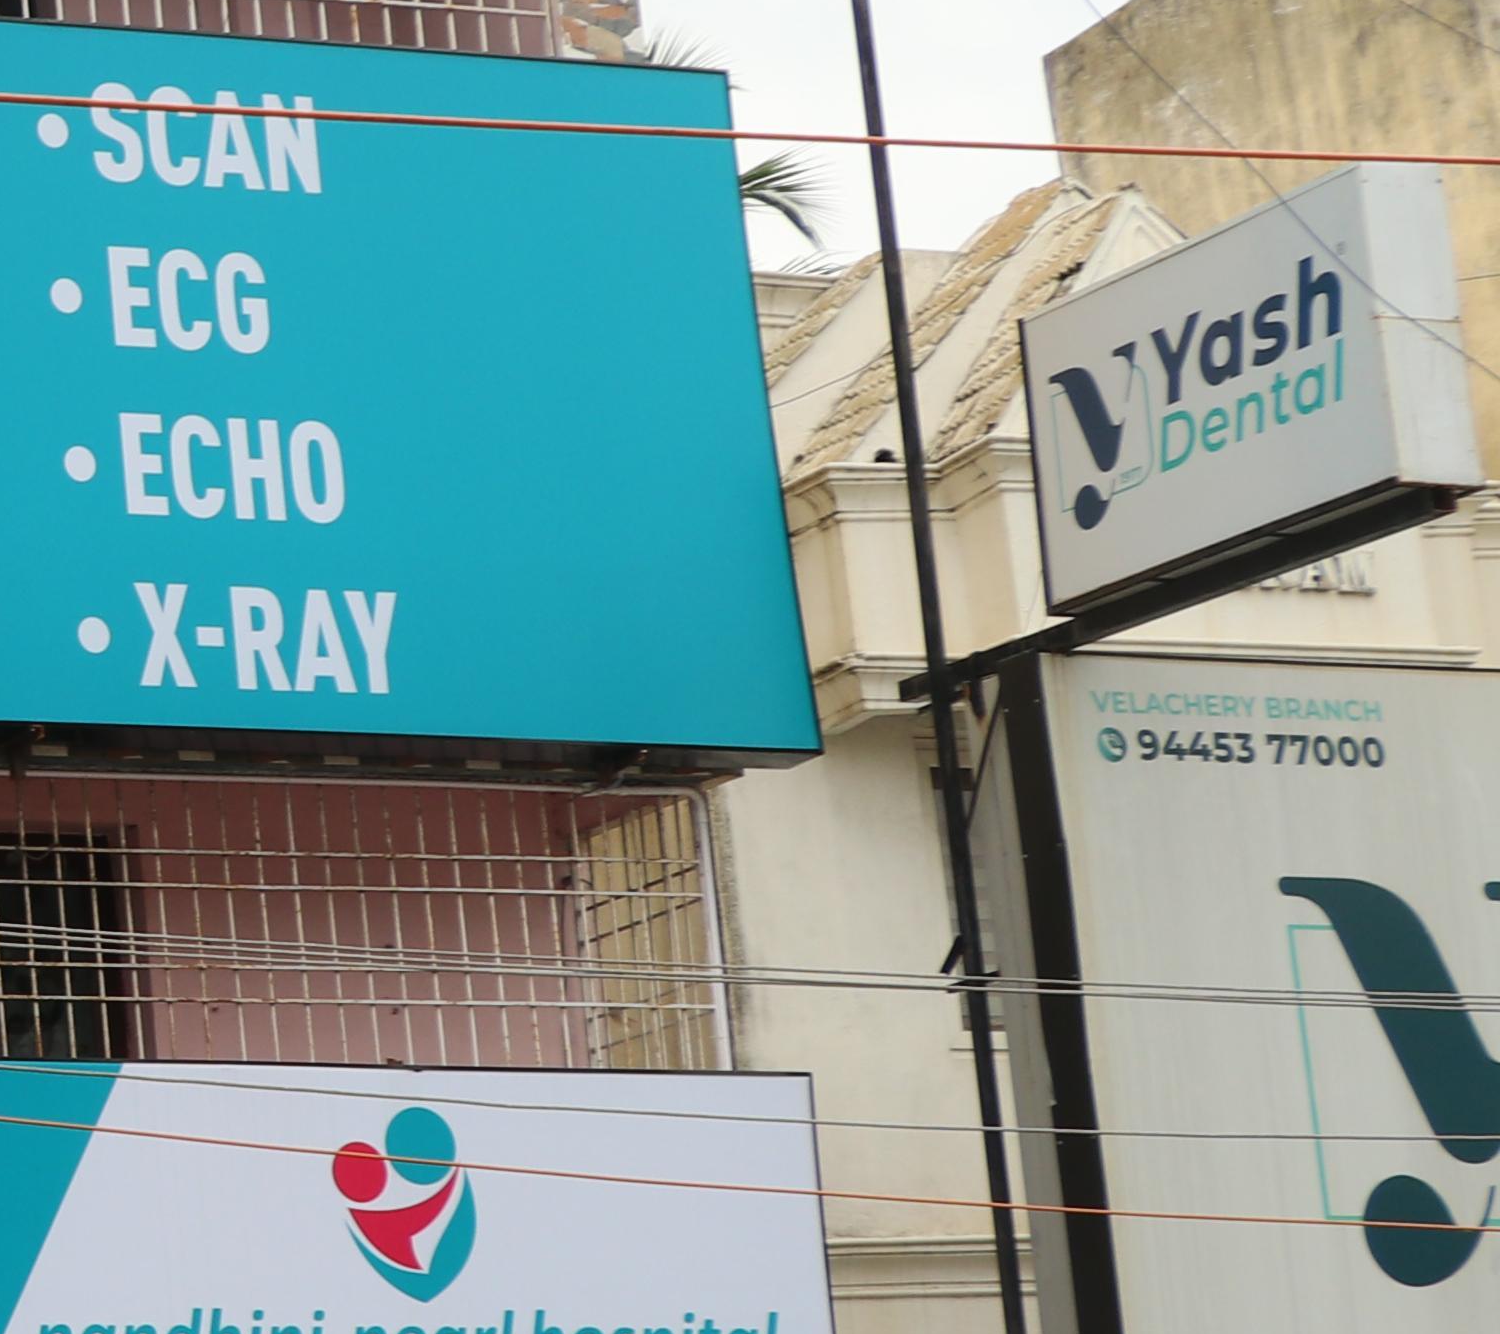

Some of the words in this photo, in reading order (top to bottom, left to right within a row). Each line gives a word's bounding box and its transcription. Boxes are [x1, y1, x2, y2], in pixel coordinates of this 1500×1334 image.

[91, 79, 320, 195] SCAN
[108, 245, 271, 356] ECG
[1150, 256, 1343, 405] Yash
[1159, 338, 1346, 473] Dental
[119, 411, 345, 525] ECHO
[135, 579, 397, 695] X-RAY
[1089, 690, 1255, 717] VELACHERY
[1265, 696, 1383, 722] BRANCH
[1137, 729, 1255, 763] 94453
[1266, 733, 1385, 767] 77000
